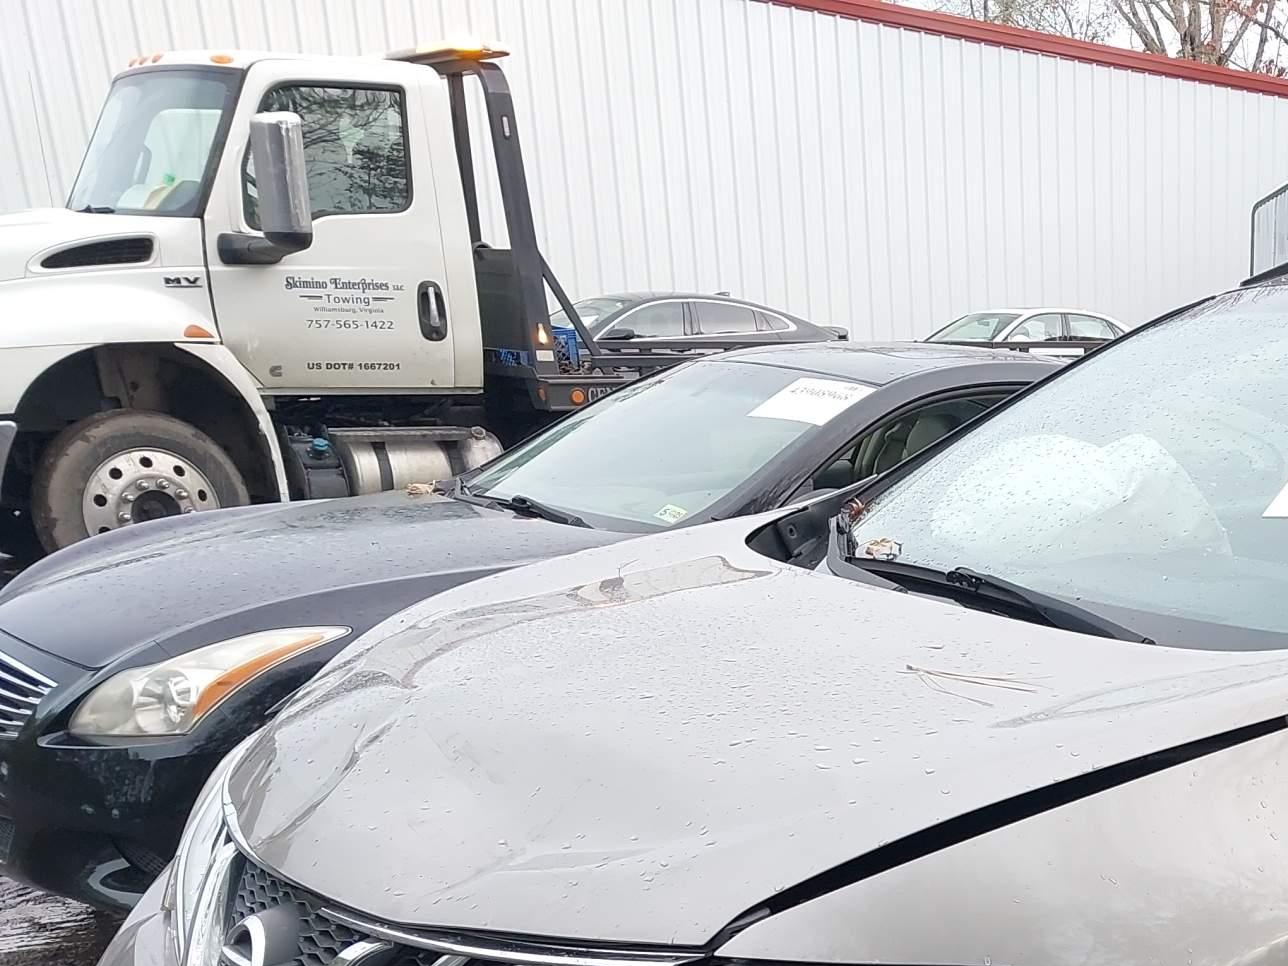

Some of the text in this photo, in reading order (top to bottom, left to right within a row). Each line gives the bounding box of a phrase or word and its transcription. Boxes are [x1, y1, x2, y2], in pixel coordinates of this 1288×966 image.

[163, 276, 201, 285] MV
[285, 276, 328, 290] Skimino
[330, 278, 390, 293] Enterprises
[325, 293, 371, 307] Towing
[359, 307, 385, 315] Virginia
[305, 319, 395, 330] 757-565-1422
[307, 362, 401, 371] US DOT# 1667201
